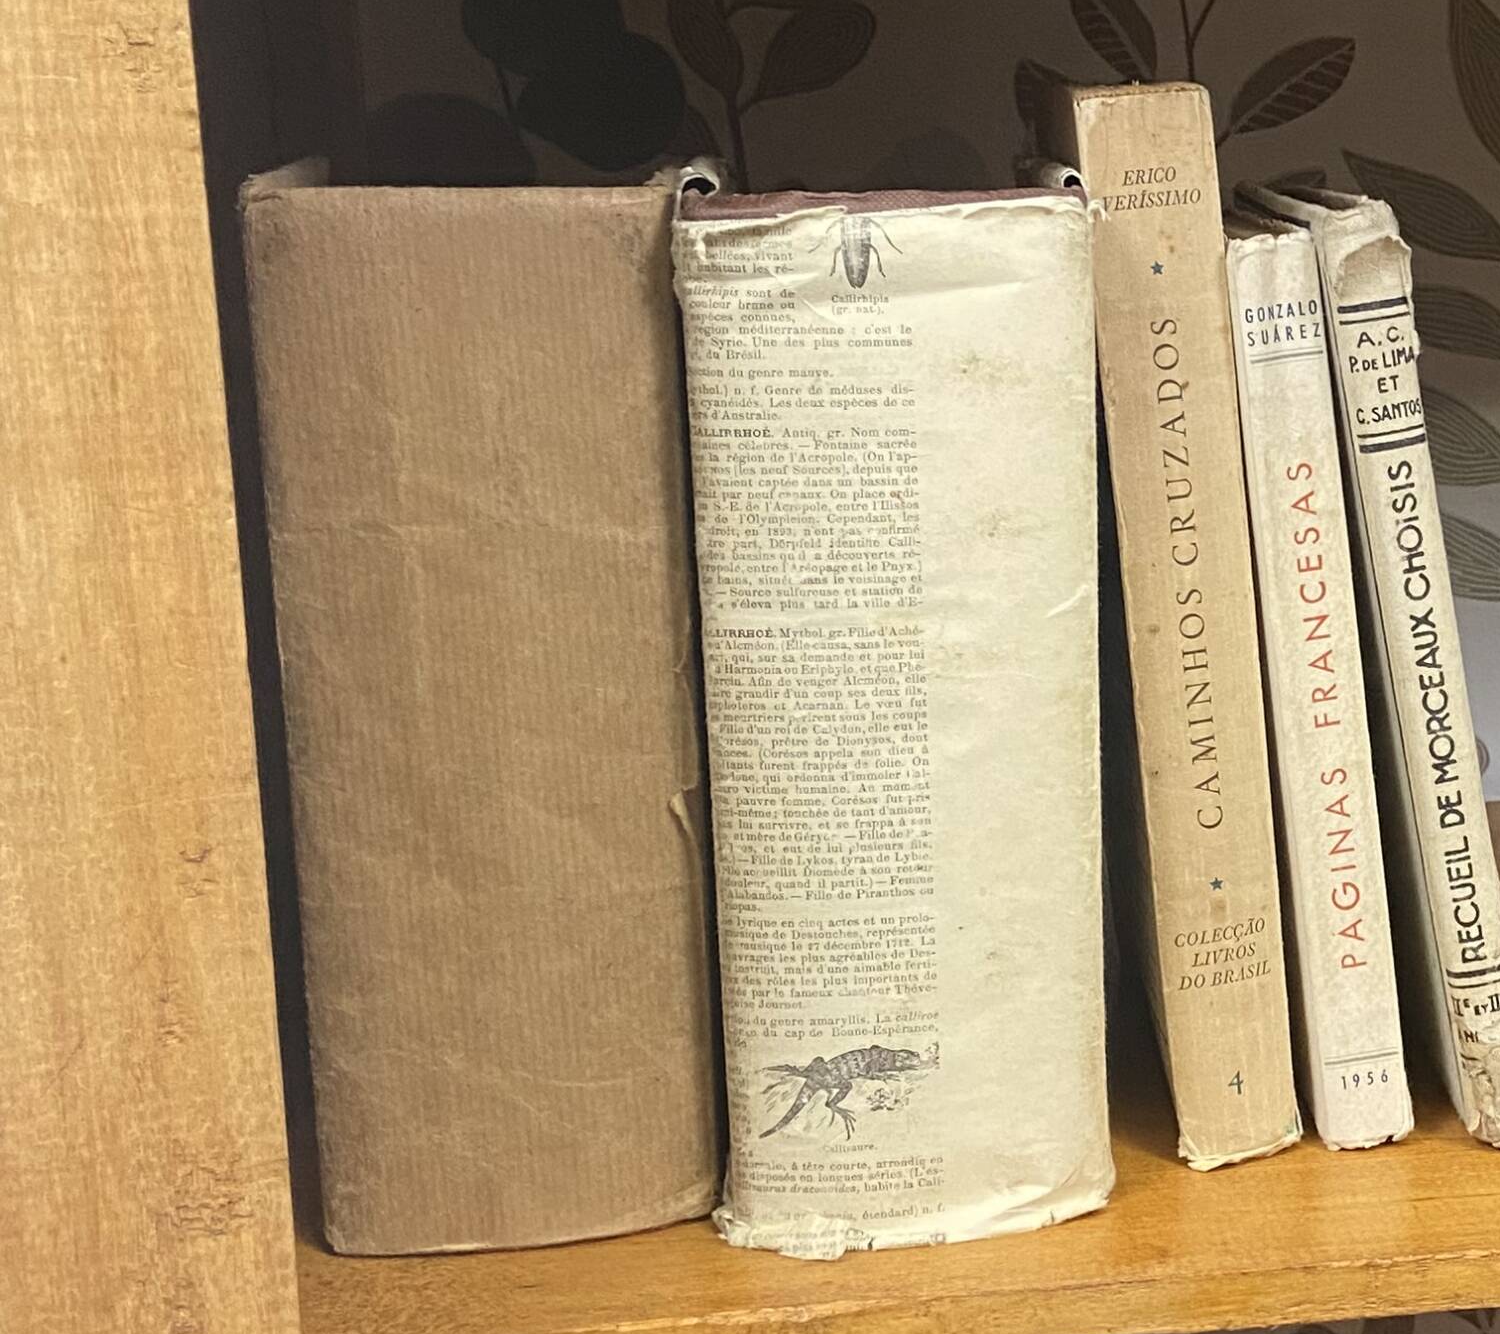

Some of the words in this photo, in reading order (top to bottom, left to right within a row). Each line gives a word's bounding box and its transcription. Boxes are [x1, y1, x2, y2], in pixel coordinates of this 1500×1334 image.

[1122, 166, 1177, 186] ERICO
[1100, 187, 1202, 213] VERÍSSIMO
[1245, 299, 1318, 324] GONZALO
[901, 325, 912, 334] le
[752, 337, 777, 347] Une
[784, 337, 805, 347] des
[814, 338, 839, 350] plus
[848, 339, 912, 347] communes
[1381, 348, 1417, 370] LIMA
[729, 369, 743, 377] du
[748, 370, 783, 380] genre
[1377, 374, 1400, 394] ET
[765, 386, 801, 395] Genre
[830, 385, 882, 395] méduses
[770, 398, 791, 407] Les
[795, 398, 824, 407] deux
[851, 427, 879, 437] Nom
[1149, 316, 1199, 568] CRUZADOS
[727, 453, 764, 466] région
[770, 453, 784, 462] de
[853, 464, 892, 478] depuis
[896, 466, 918, 478] que
[860, 476, 898, 486] bassin
[722, 492, 742, 502] par
[830, 490, 846, 499] On
[814, 599, 838, 609] tard
[848, 599, 858, 608] la
[1286, 460, 1342, 729] FRANCESAS
[878, 653, 906, 664] pour
[814, 687, 842, 701] coup
[872, 687, 900, 696] deux
[1404, 606, 1462, 786] MORCEAUX
[1176, 586, 1223, 830] CAMINHOS
[912, 757, 929, 765] On
[1438, 794, 1466, 829] DE
[1320, 767, 1368, 970] PAGINAS
[1439, 834, 1485, 962] RECUEIL
[828, 919, 859, 927] actes
[864, 917, 875, 925] et
[1174, 918, 1265, 948] COLECÇÃO
[1191, 942, 1257, 967] LIVROS
[1179, 969, 1207, 991] DO
[1210, 961, 1271, 986] BRASIL
[1227, 1070, 1245, 1095] 4
[1340, 1068, 1389, 1090] 1956
